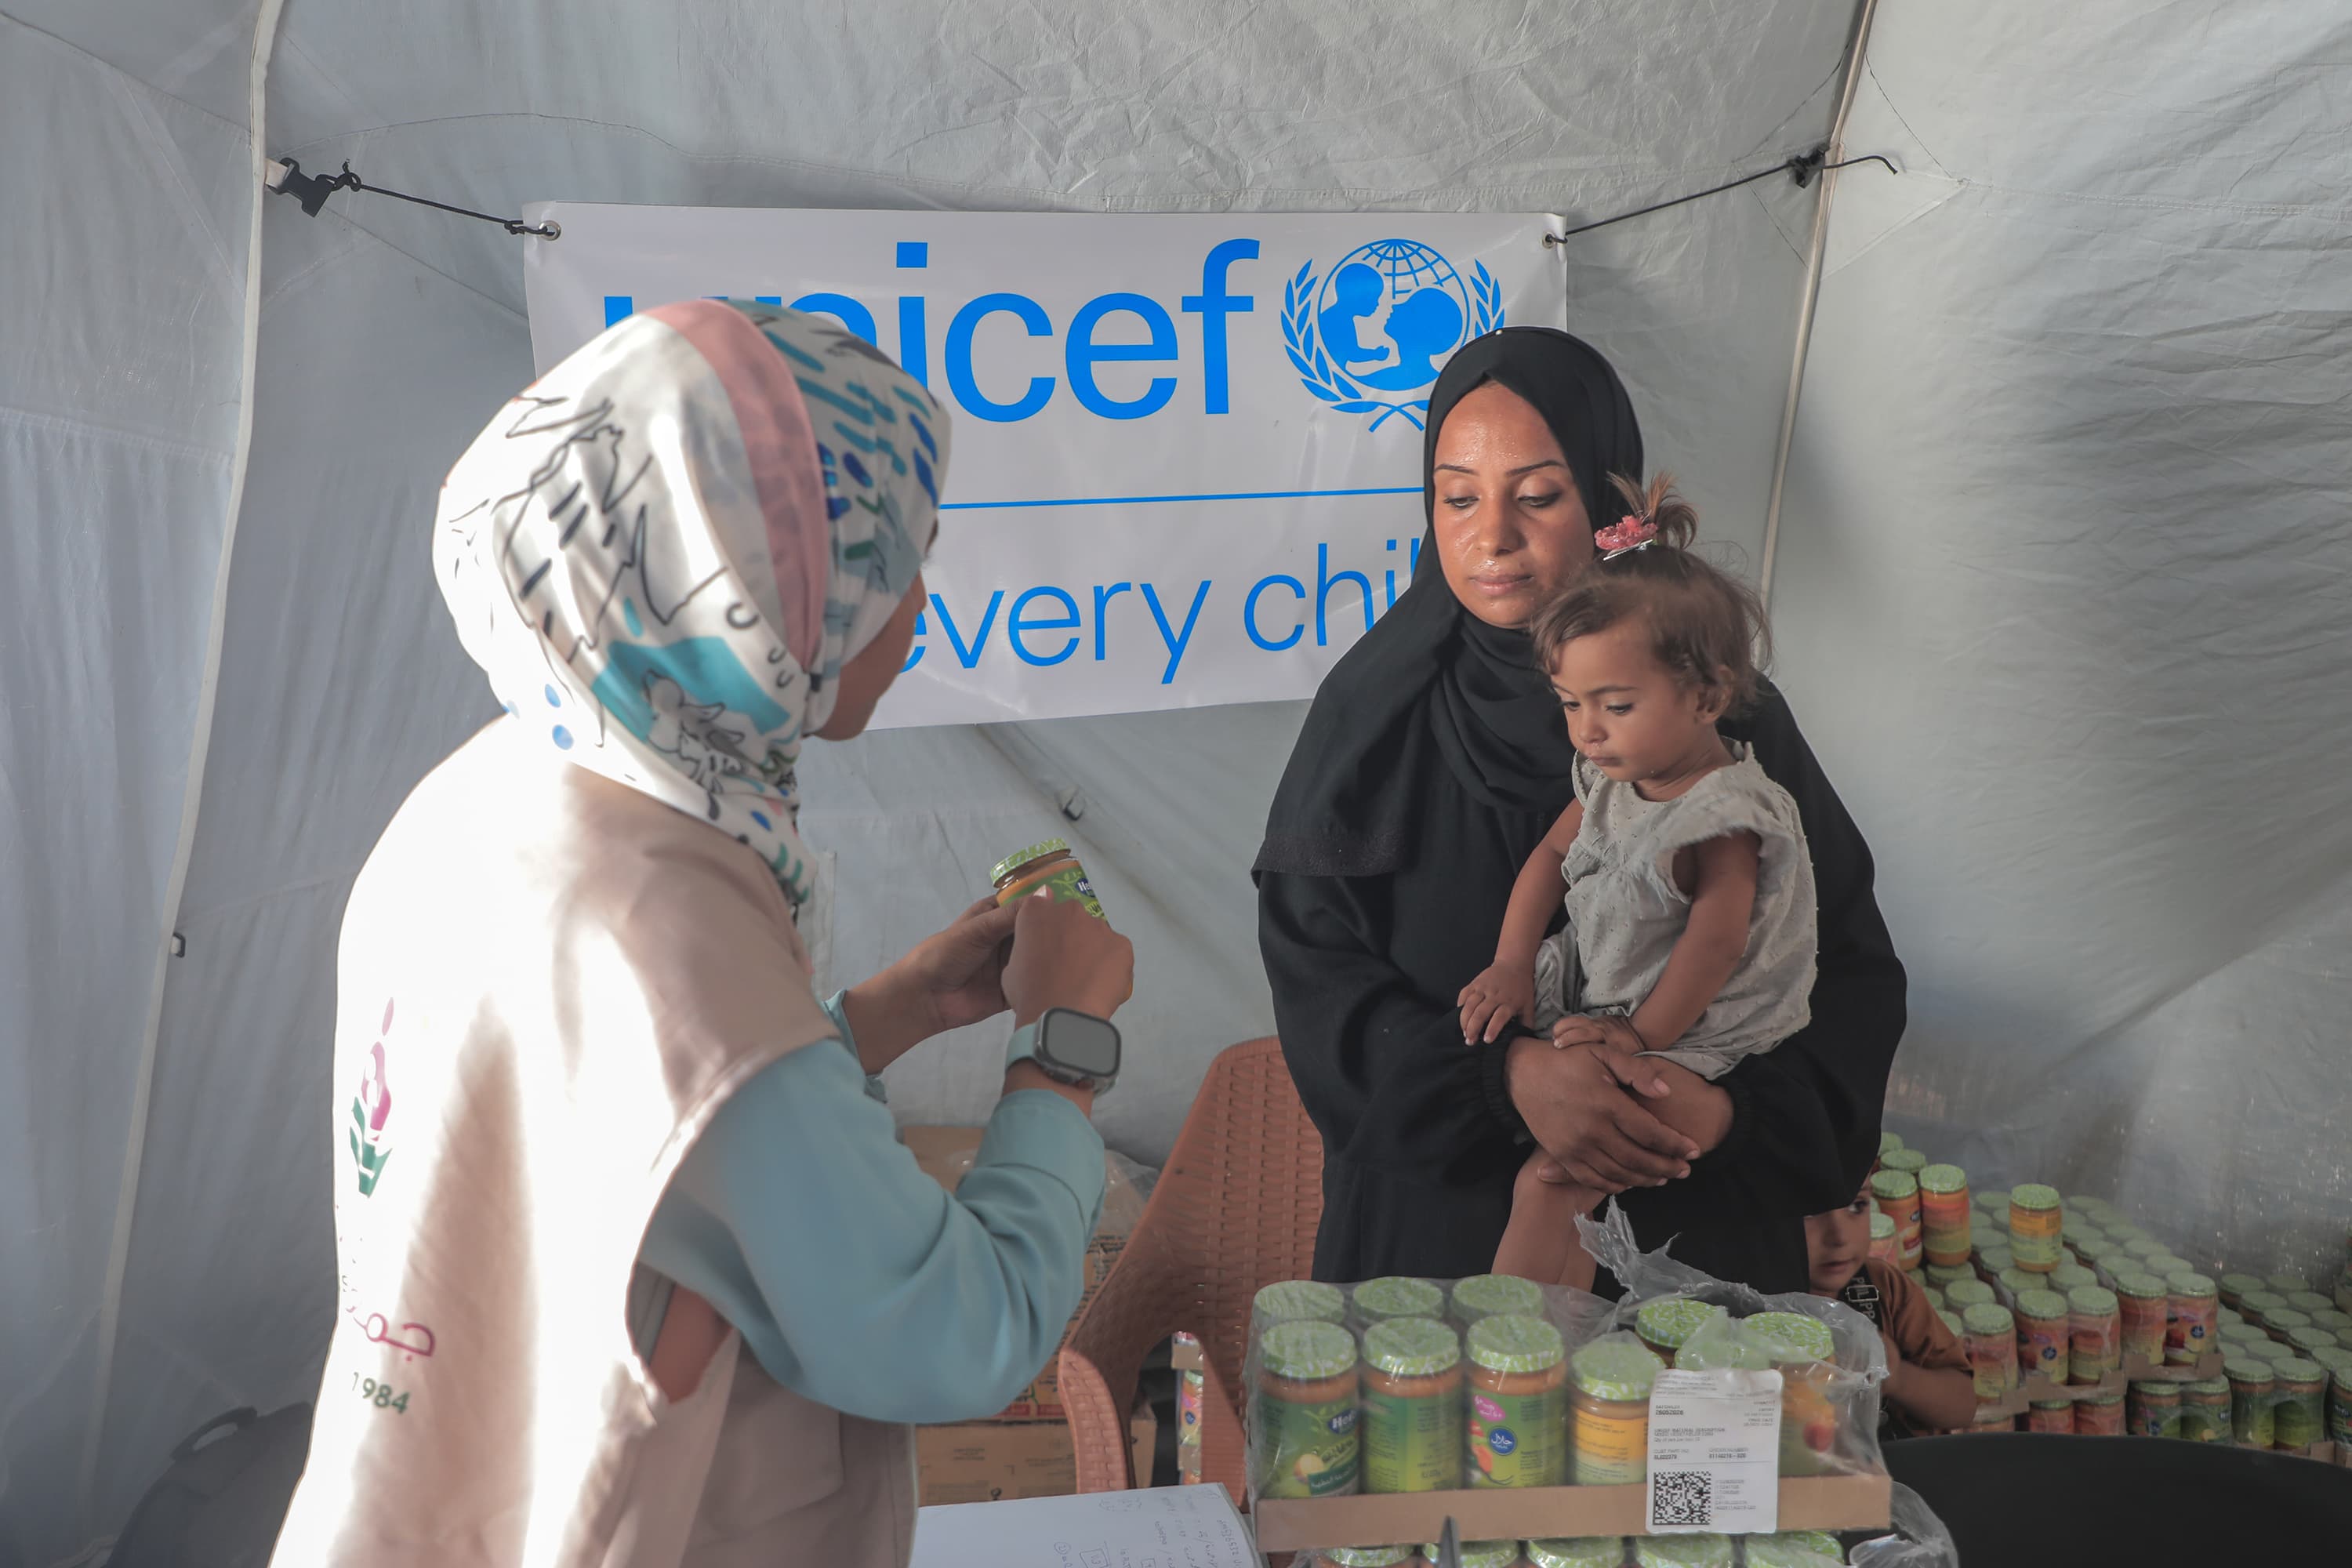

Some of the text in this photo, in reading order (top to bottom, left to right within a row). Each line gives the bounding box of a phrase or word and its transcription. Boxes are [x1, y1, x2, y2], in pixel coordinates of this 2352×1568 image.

[604, 239, 1260, 423] icef
[351, 1371, 410, 1414] 1984
[1491, 1432, 1513, 1446] حلال
